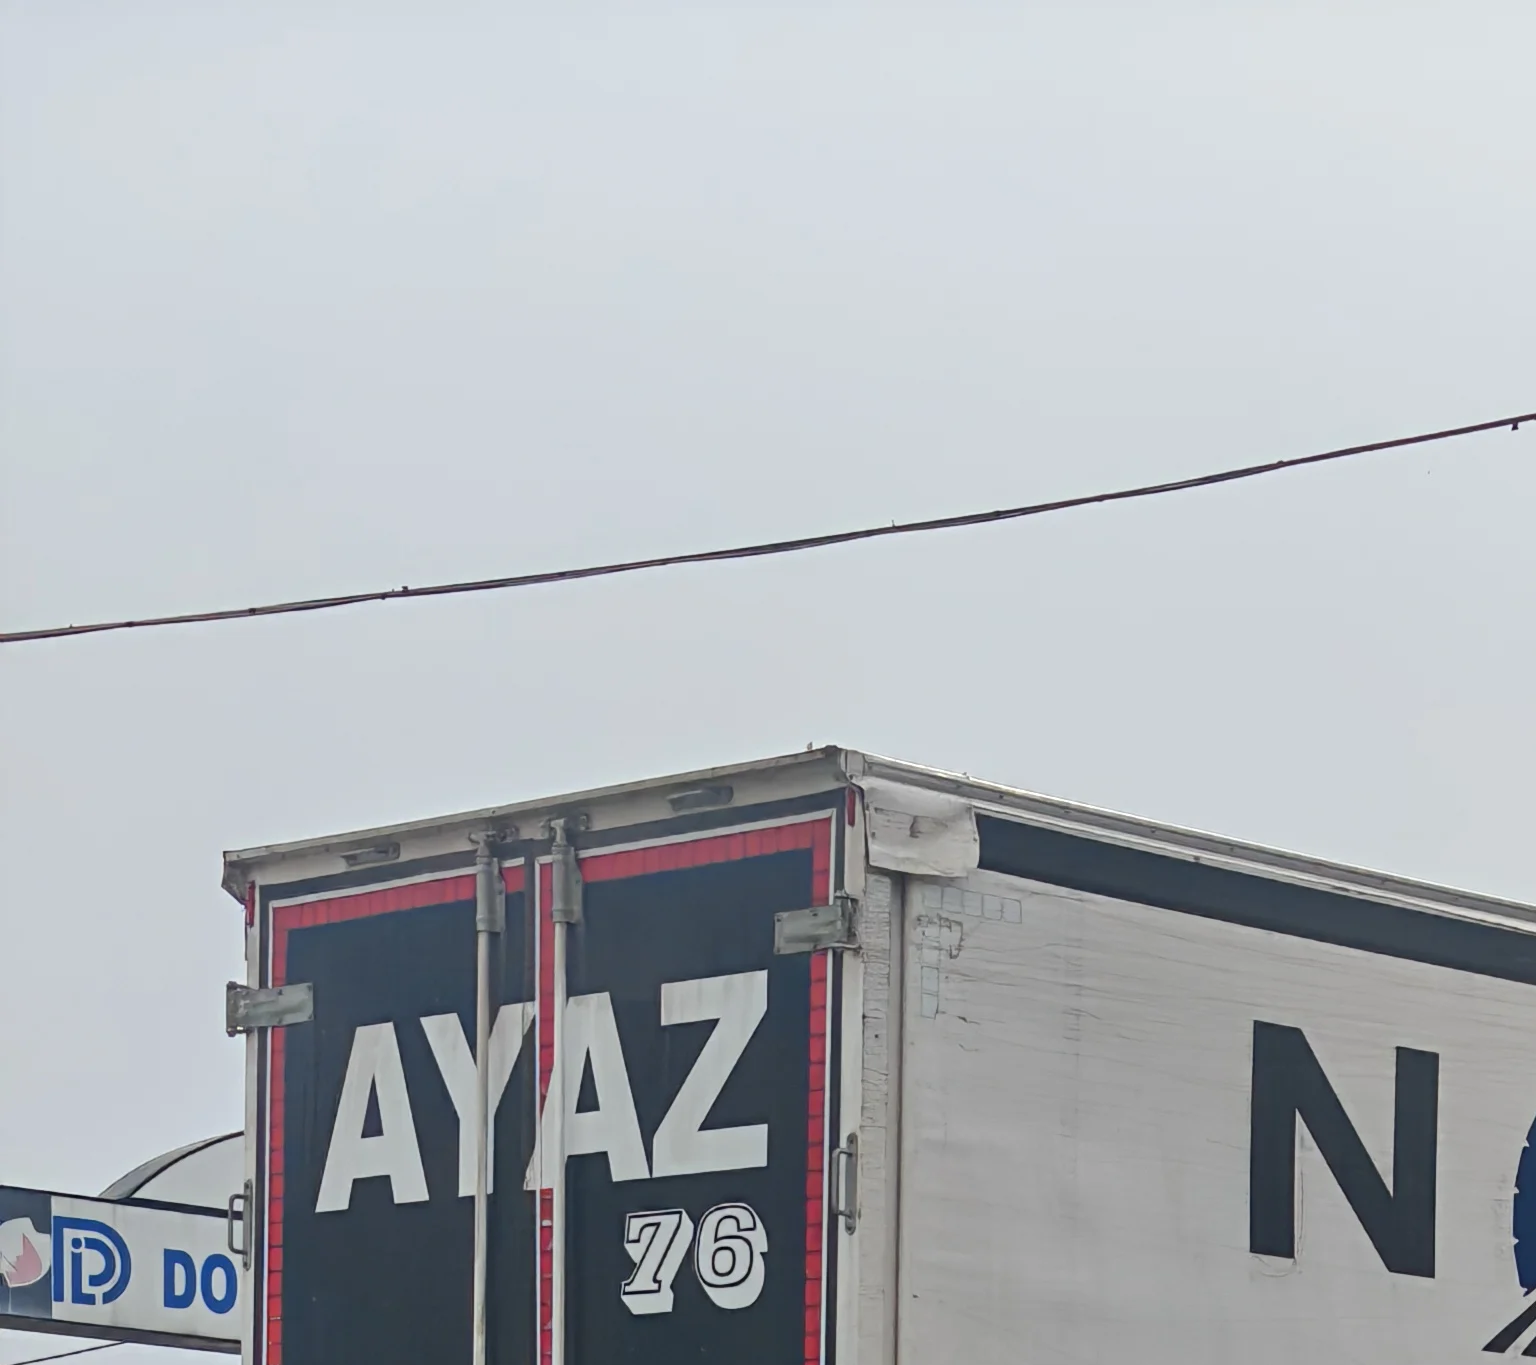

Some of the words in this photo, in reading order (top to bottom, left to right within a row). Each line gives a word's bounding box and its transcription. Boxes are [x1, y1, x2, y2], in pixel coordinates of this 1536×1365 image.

[314, 969, 768, 1213] AYAZ
[163, 1248, 238, 1314] DO
[620, 1202, 769, 1314] 76
